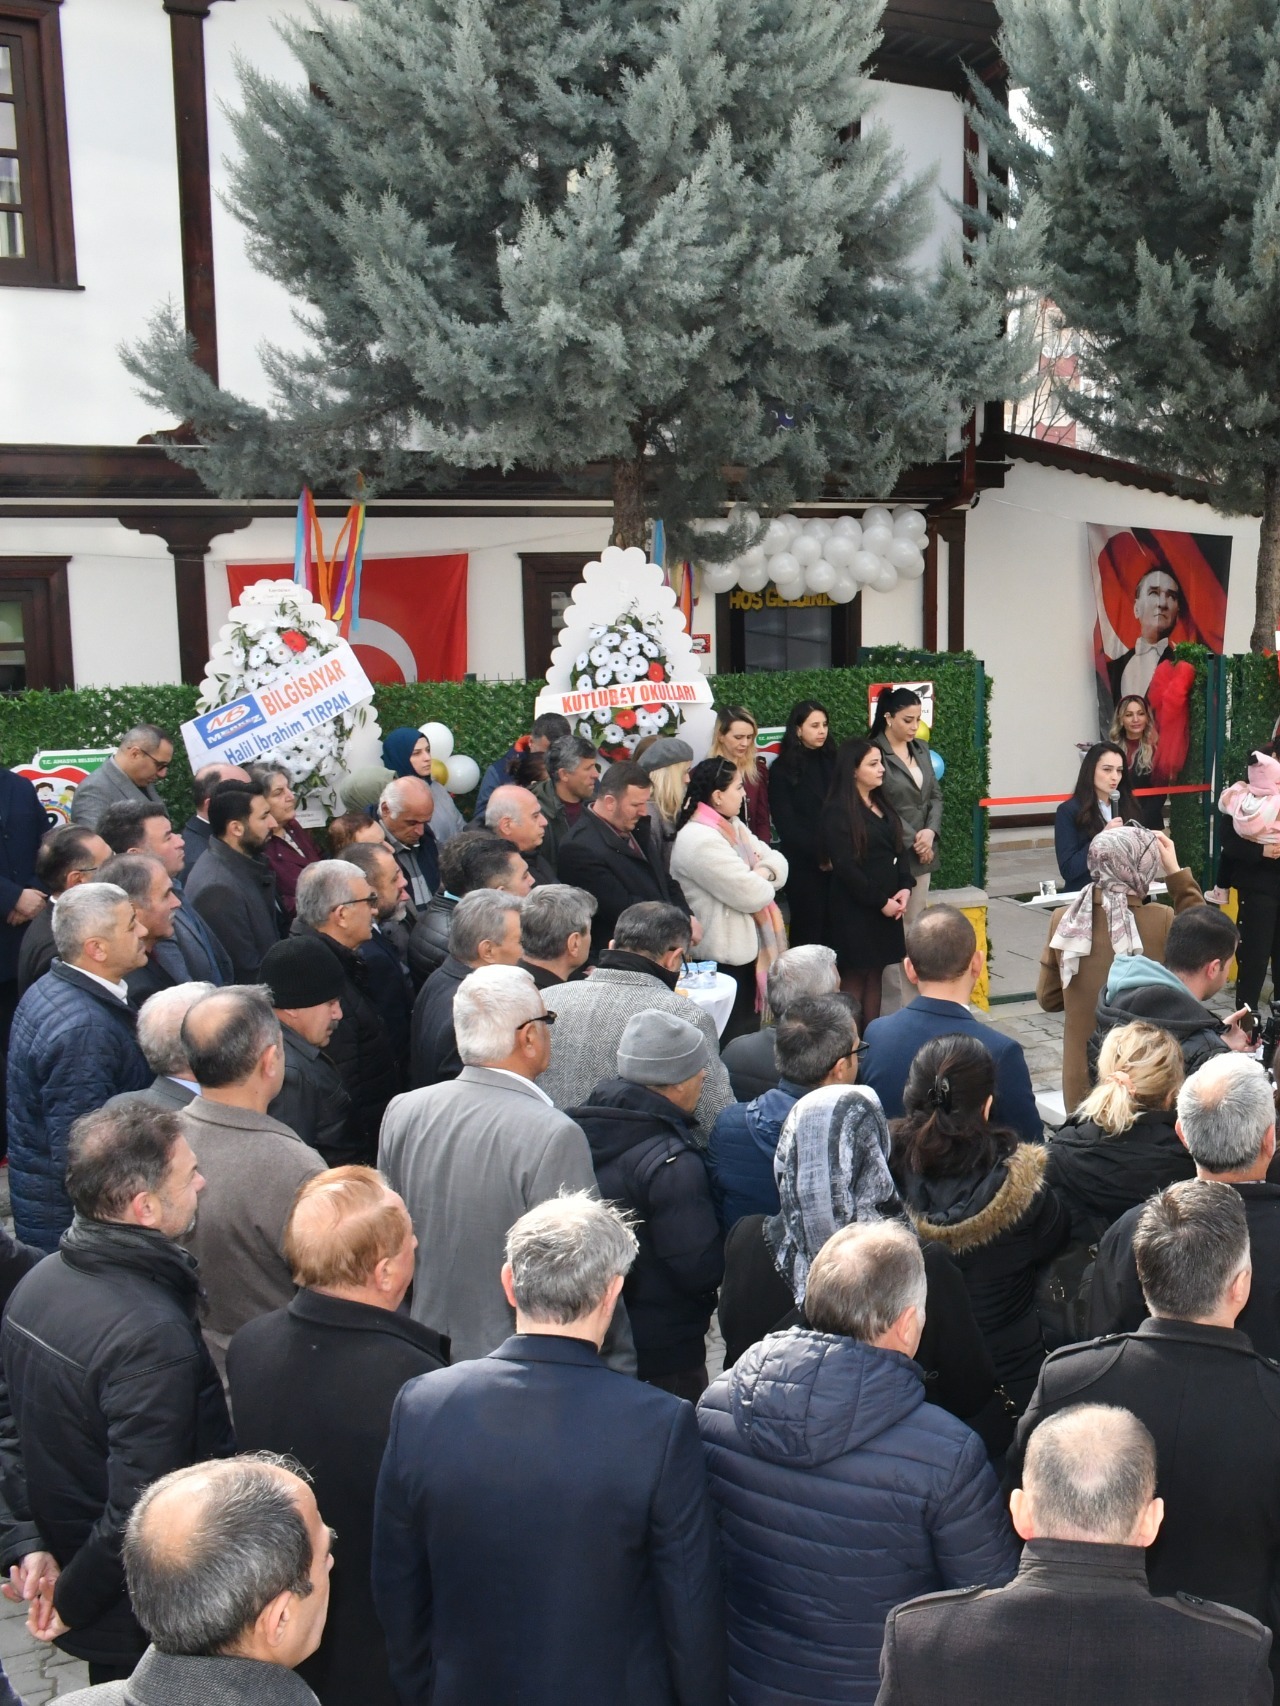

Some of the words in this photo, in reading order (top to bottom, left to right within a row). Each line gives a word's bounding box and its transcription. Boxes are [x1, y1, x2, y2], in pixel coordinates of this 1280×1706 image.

[729, 590, 763, 612] HOŞ
[260, 659, 346, 716] BİLGİSAYAR
[561, 685, 637, 713] KUTLUBEY
[640, 685, 697, 702] OKULLARI
[224, 741, 255, 765] Halil
[252, 720, 305, 751] İbrahim
[302, 690, 351, 727] TIRPAN
